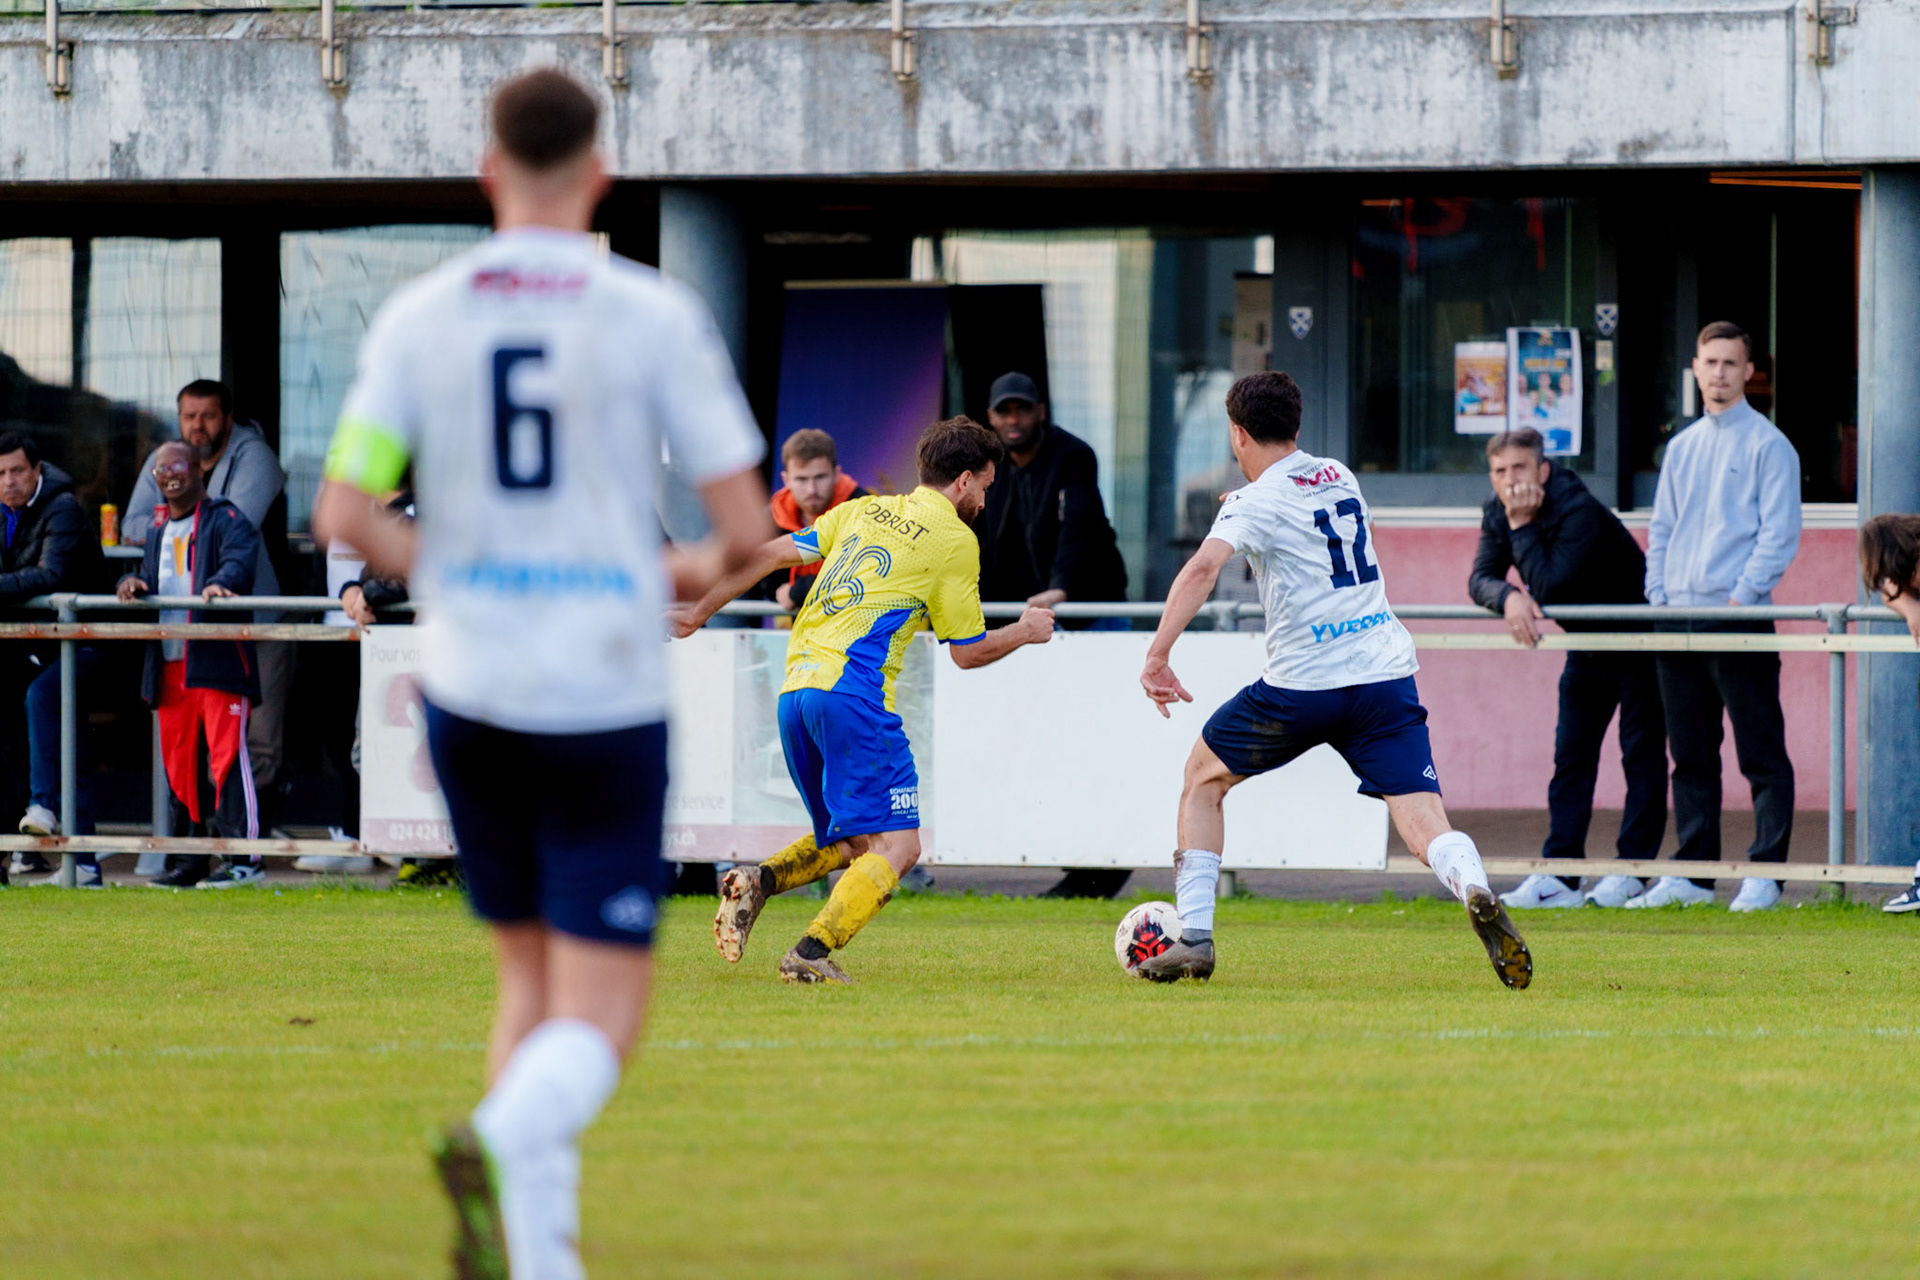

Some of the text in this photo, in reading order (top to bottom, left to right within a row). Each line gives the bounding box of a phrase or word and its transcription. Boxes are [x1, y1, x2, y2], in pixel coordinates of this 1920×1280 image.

[493, 347, 553, 489] 6
[864, 502, 930, 541] OBRIST
[1313, 497, 1379, 590] 12
[805, 533, 892, 616] 16
[389, 823, 413, 841] 024
[416, 823, 439, 841] 424
